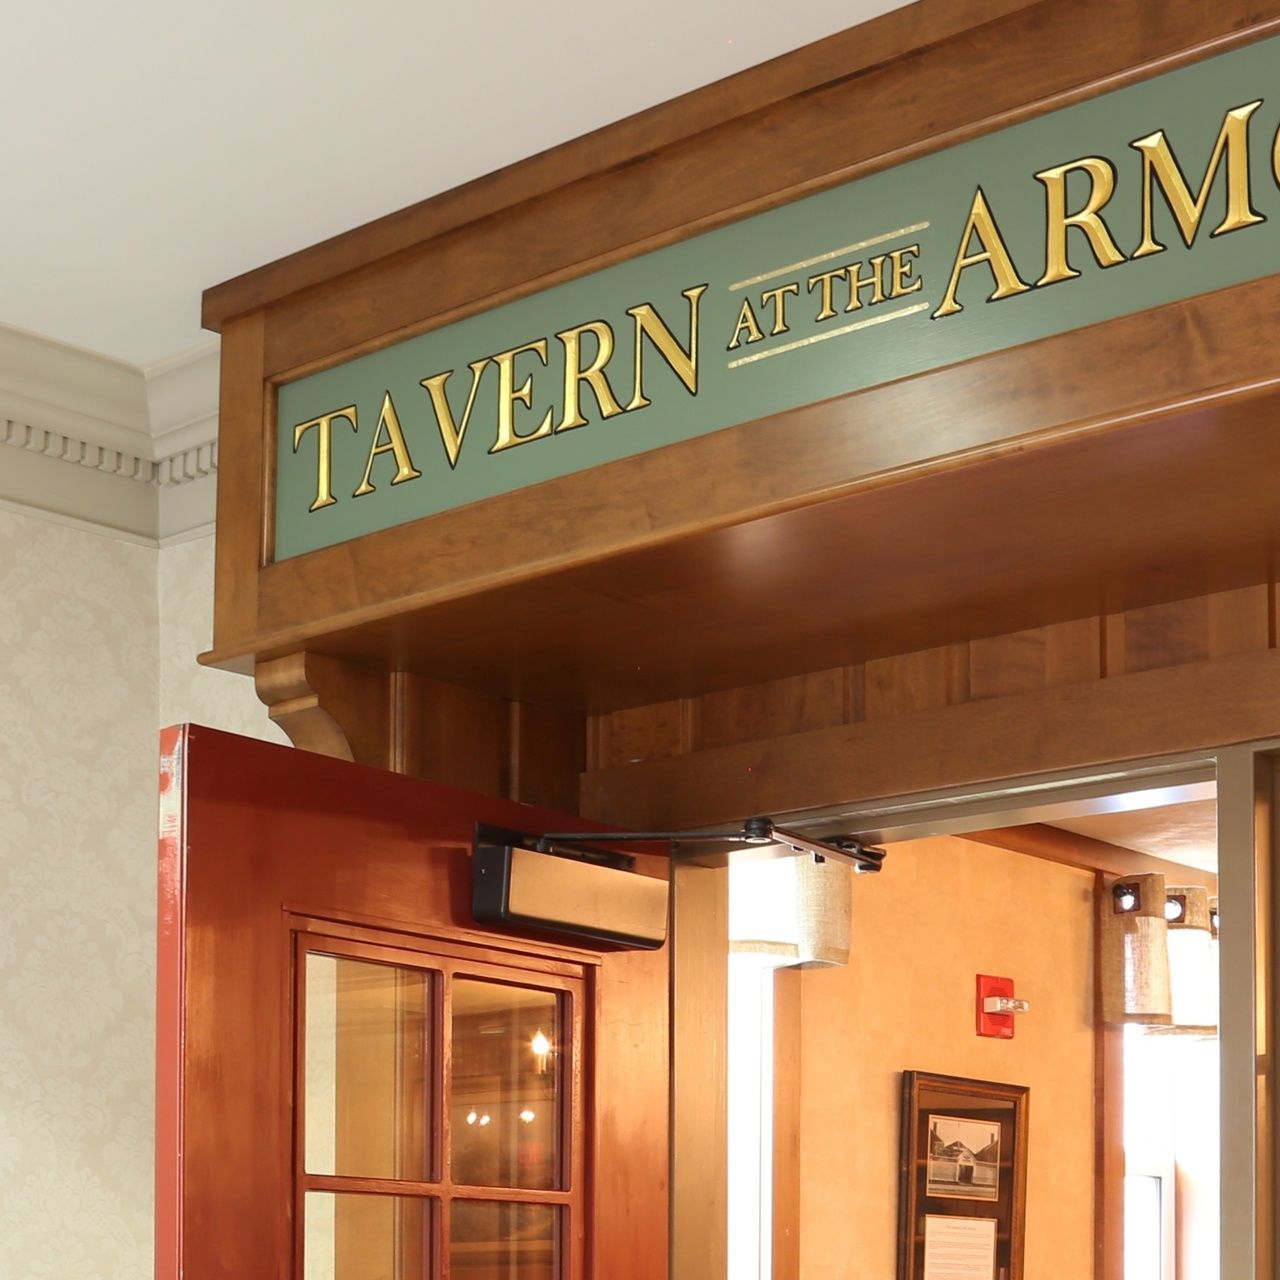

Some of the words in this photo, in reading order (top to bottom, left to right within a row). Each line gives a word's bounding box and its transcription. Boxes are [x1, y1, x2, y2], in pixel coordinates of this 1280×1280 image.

[293, 283, 708, 513] TAVERN
[726, 282, 800, 351] AT
[807, 244, 923, 322] THE
